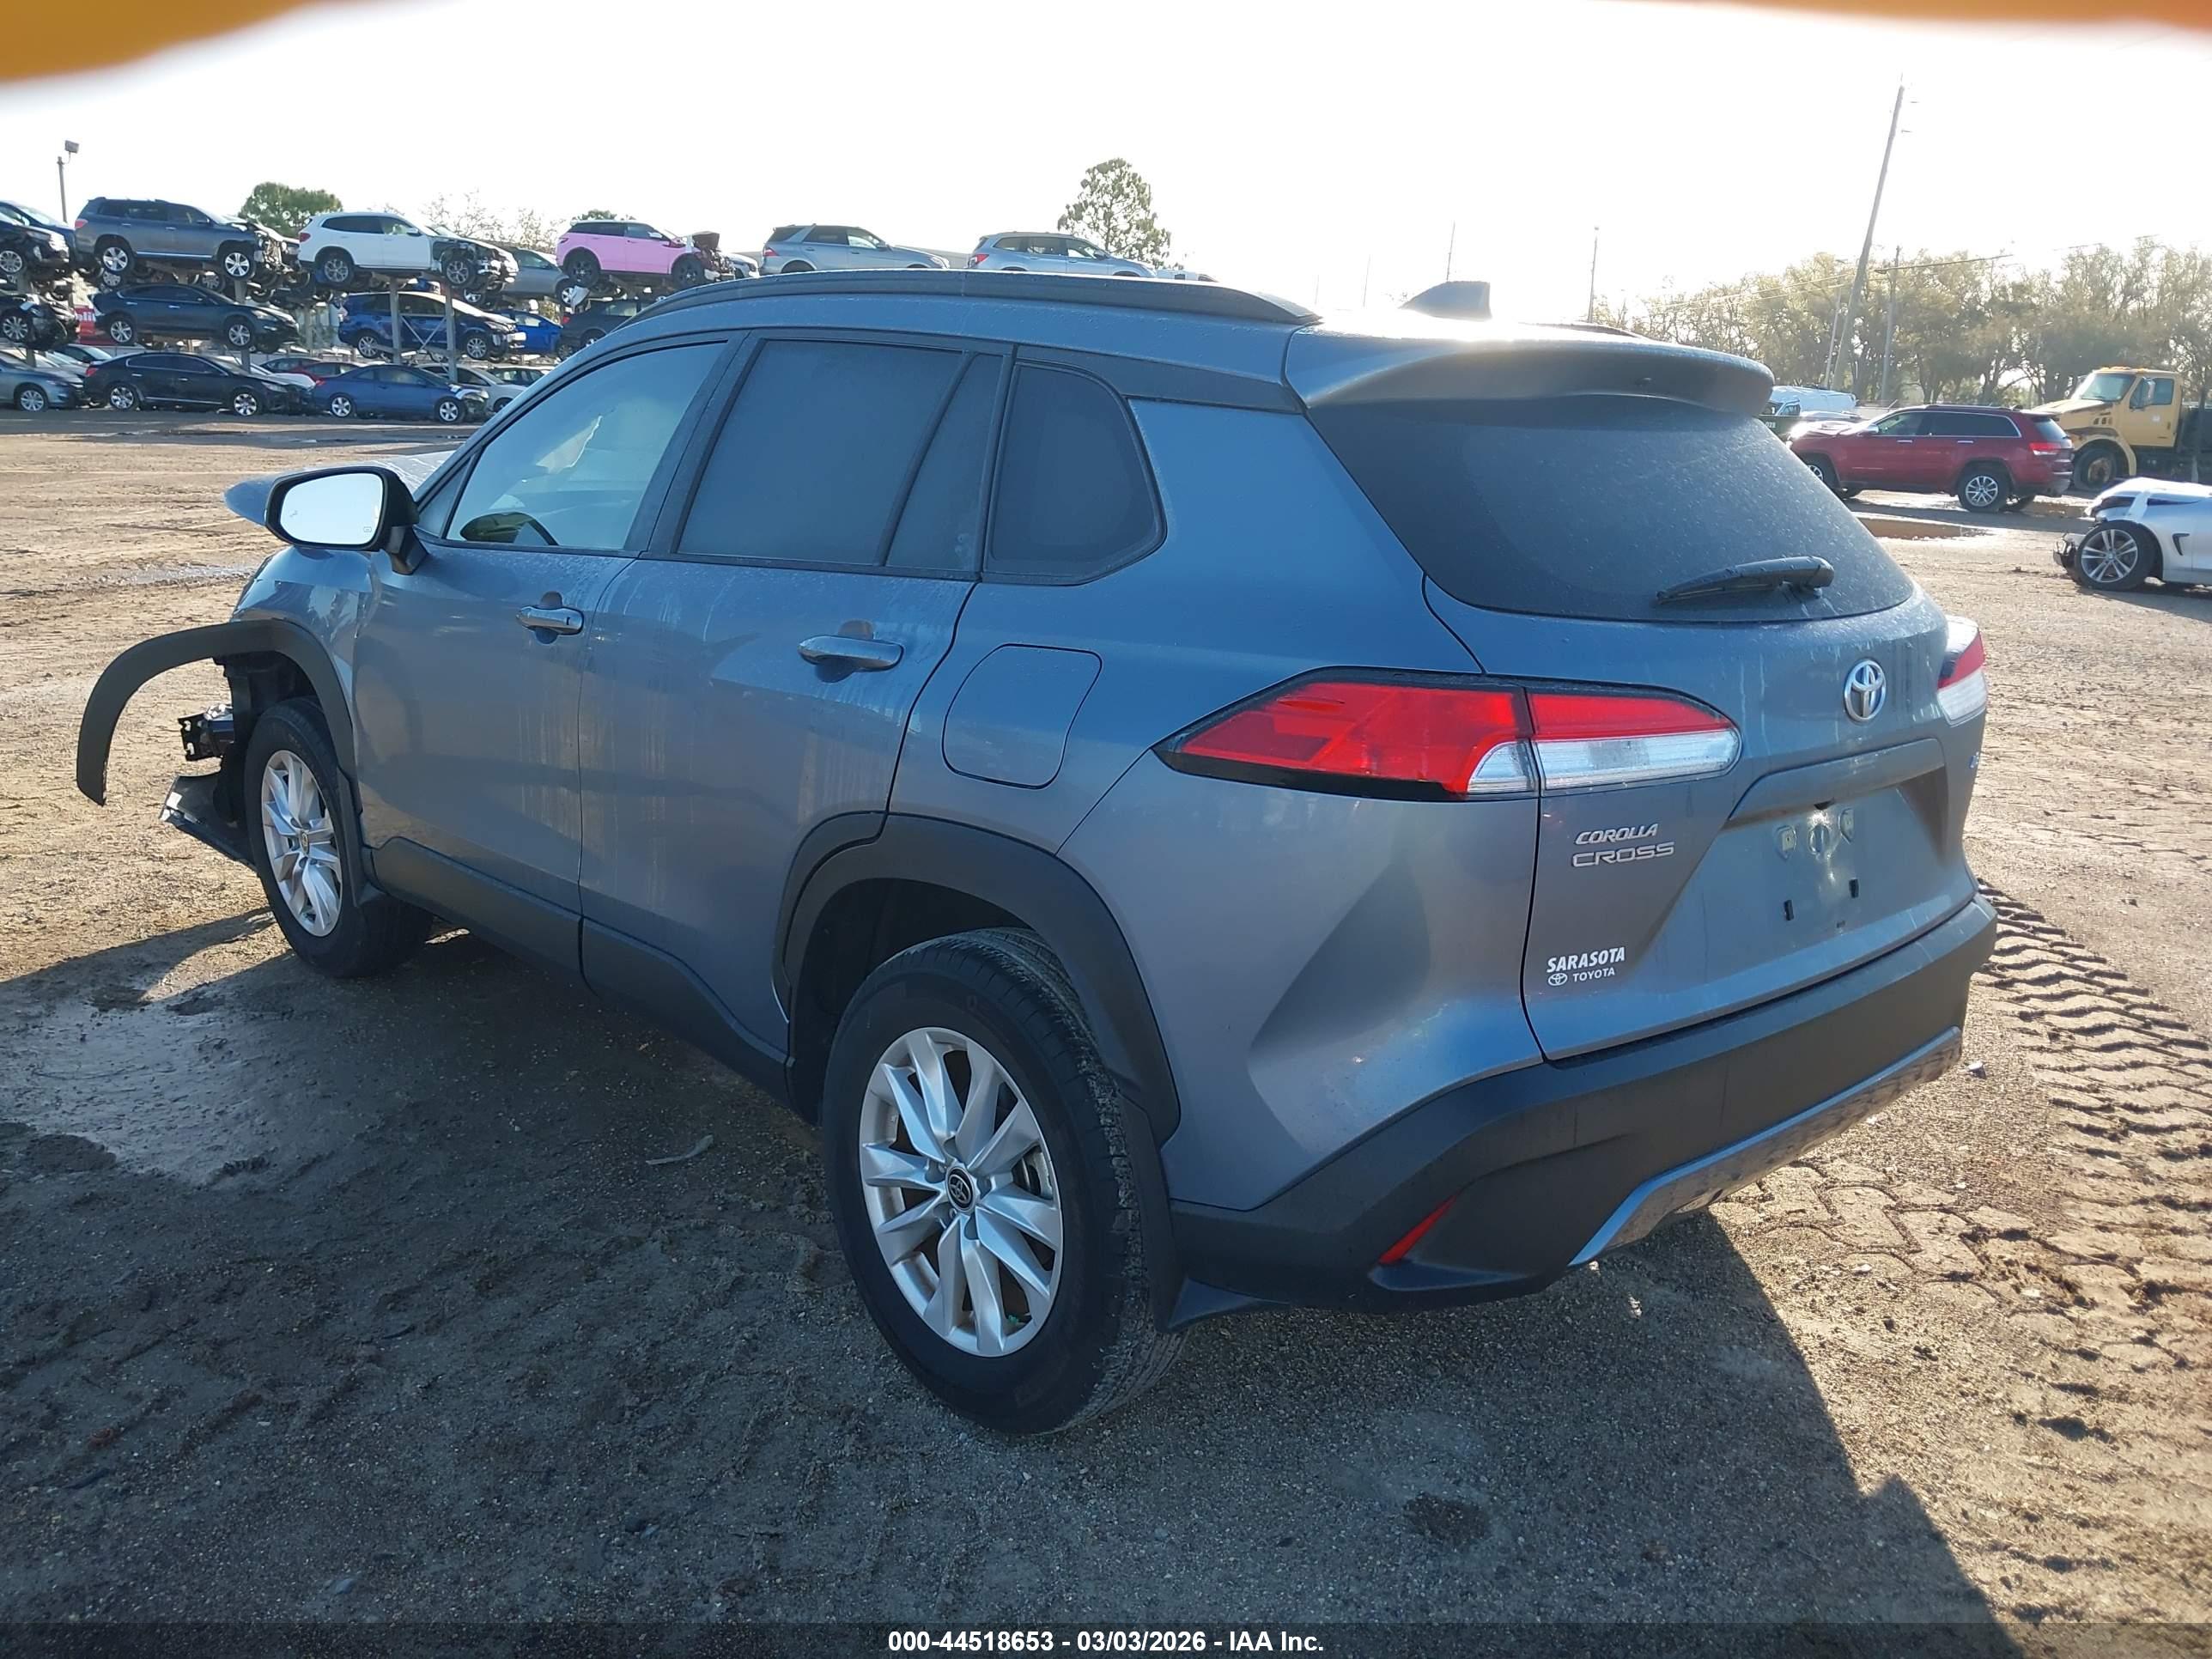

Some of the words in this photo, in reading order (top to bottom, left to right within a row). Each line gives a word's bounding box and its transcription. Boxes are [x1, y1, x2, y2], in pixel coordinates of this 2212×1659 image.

[1575, 823, 1659, 845] COROLLA
[1572, 842, 1674, 867] CROSS
[1547, 946, 1626, 973] SARASOTA
[1572, 967, 1615, 982] TOYOTA
